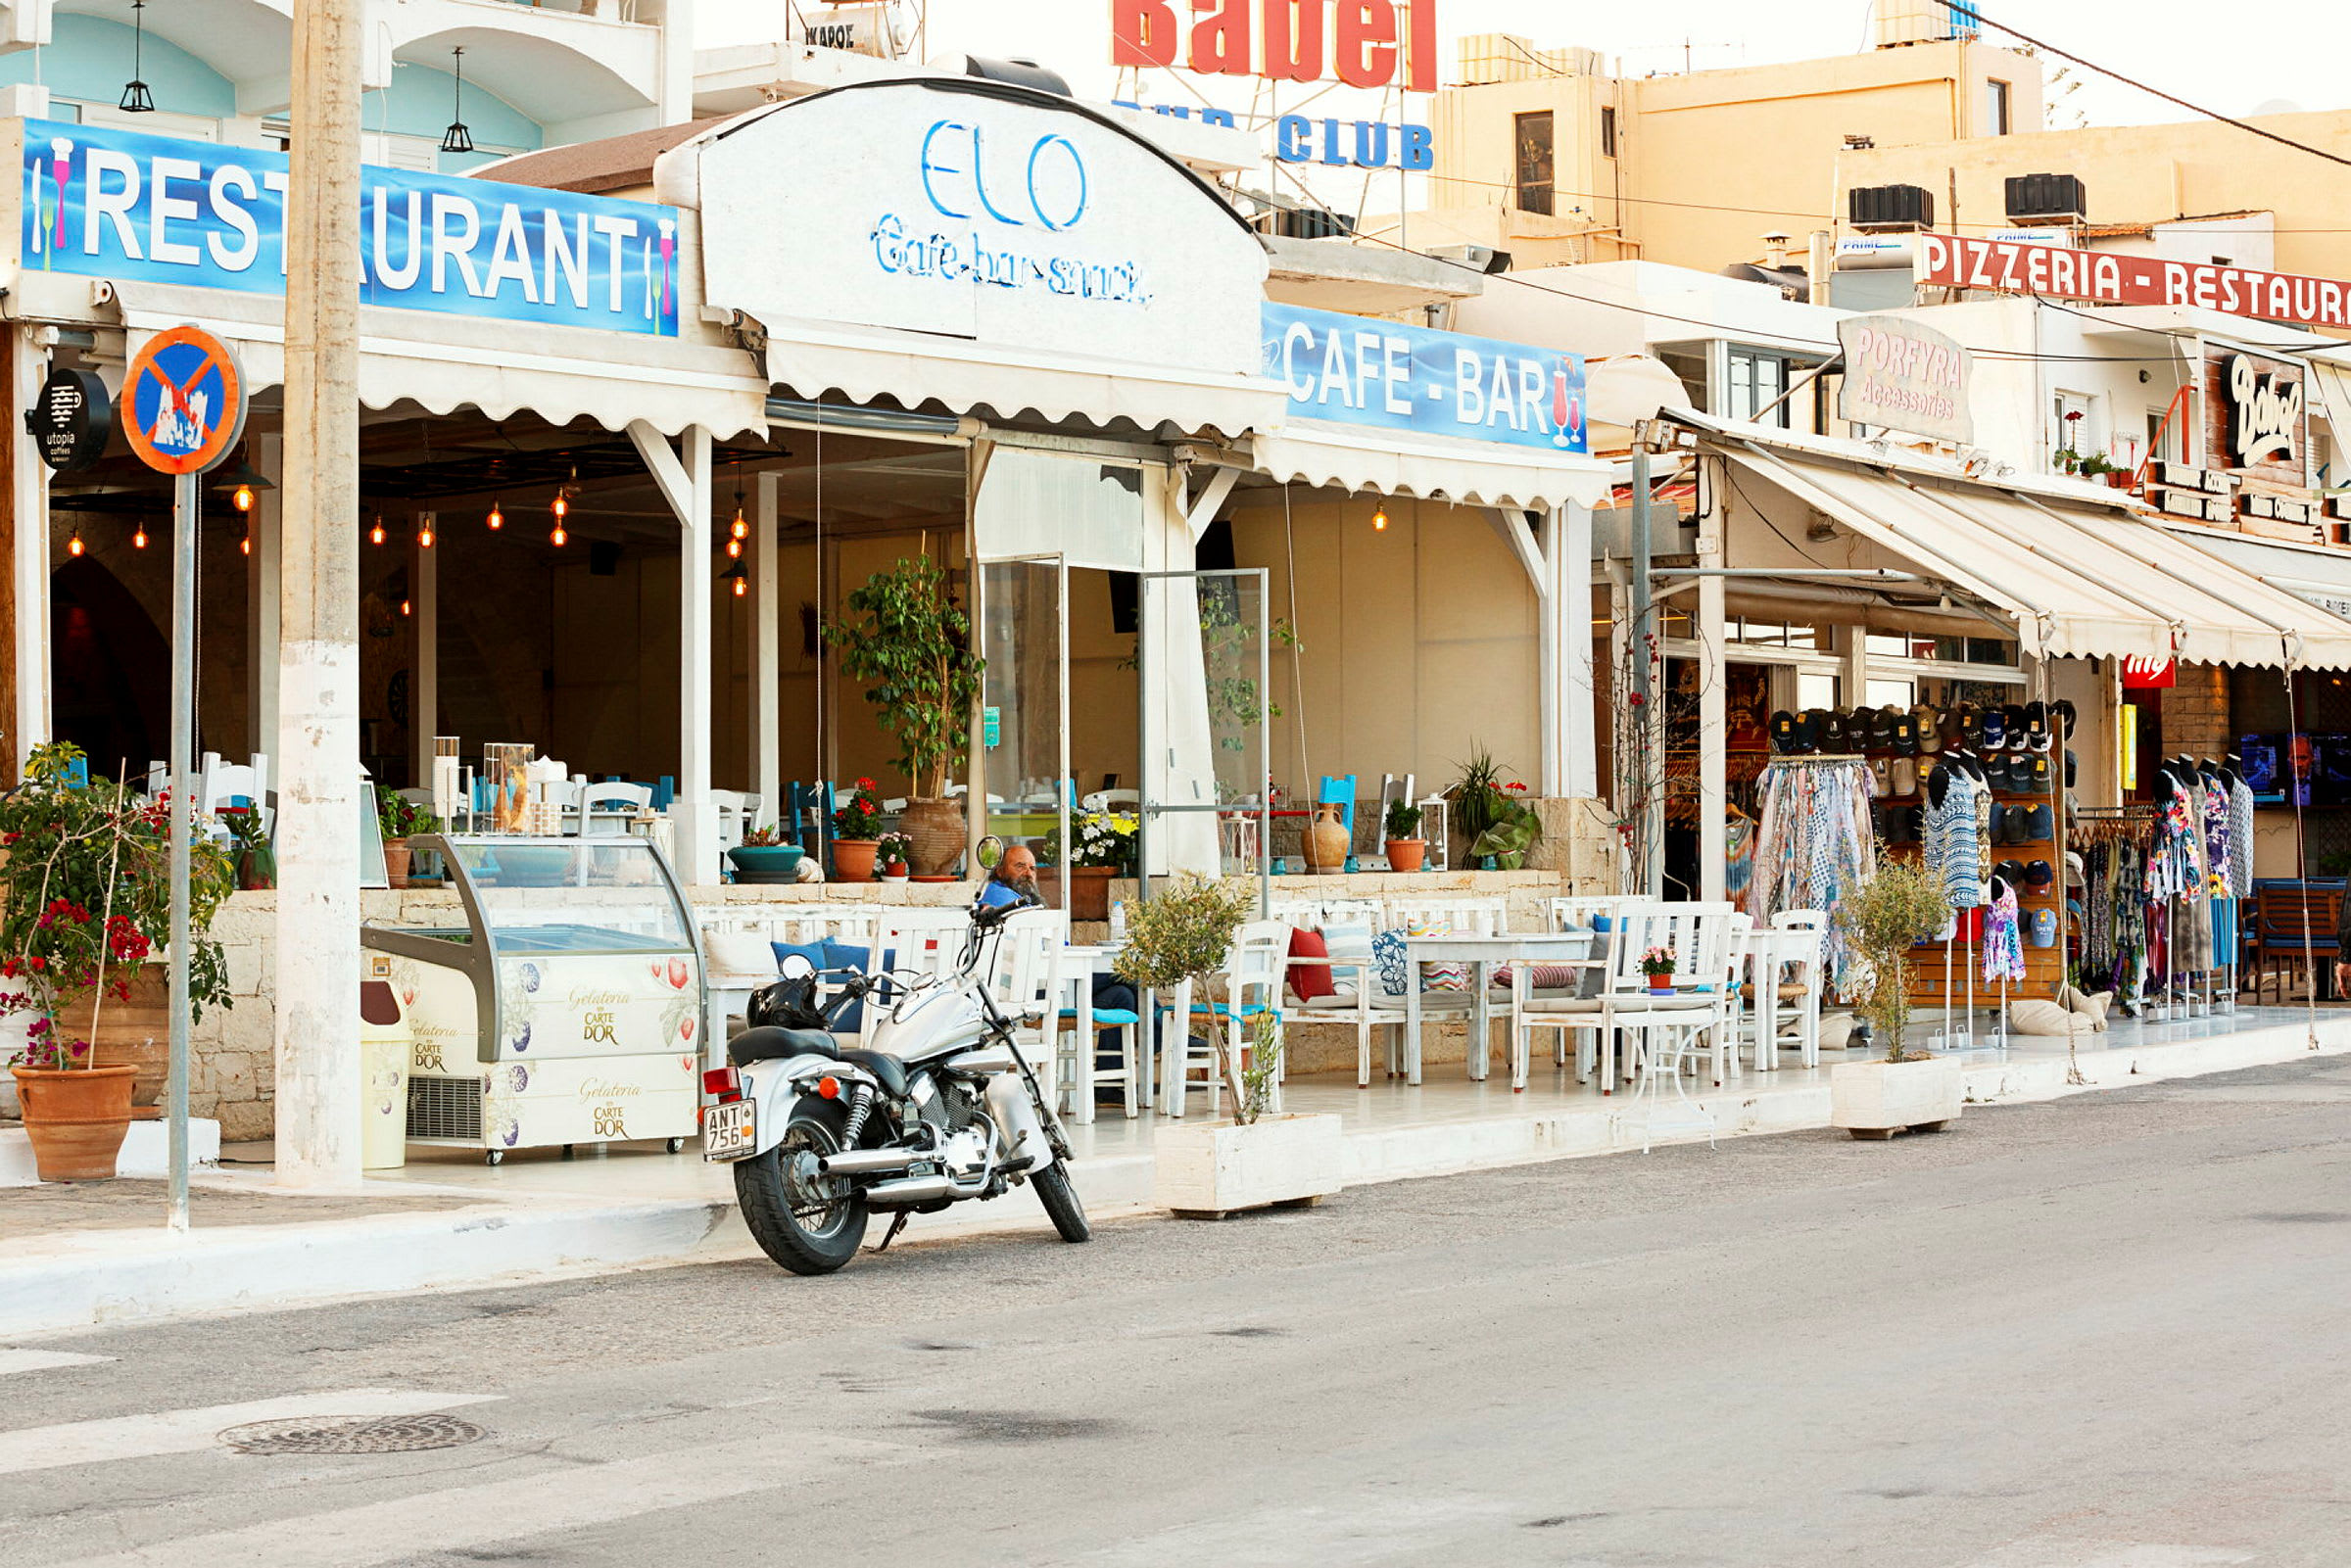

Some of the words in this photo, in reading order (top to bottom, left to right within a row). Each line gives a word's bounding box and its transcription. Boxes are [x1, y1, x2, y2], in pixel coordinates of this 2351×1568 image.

[1276, 115, 1433, 170] CLUB
[921, 119, 1087, 232] ELO
[84, 147, 638, 313] RESTURANT
[1843, 239, 1882, 249] PRIME
[1922, 235, 2121, 299] PIZZERIA
[2164, 262, 2351, 324] RESTAUR
[1857, 327, 1962, 391] PORFYRA
[1282, 320, 1413, 415] CAFE
[1455, 348, 1550, 435] BAR
[1862, 375, 1955, 420] Accessories
[2231, 353, 2301, 468] Babel
[46, 431, 75, 447] utopia
[566, 986, 631, 1012] Gelateria
[412, 1019, 459, 1037] elateria
[583, 1011, 614, 1025] CARTE
[414, 1042, 442, 1055] CARTE
[579, 1076, 643, 1105] Gelateria
[594, 1106, 624, 1120] CARTE
[709, 1107, 739, 1130] ANT
[709, 1126, 740, 1150] 756
